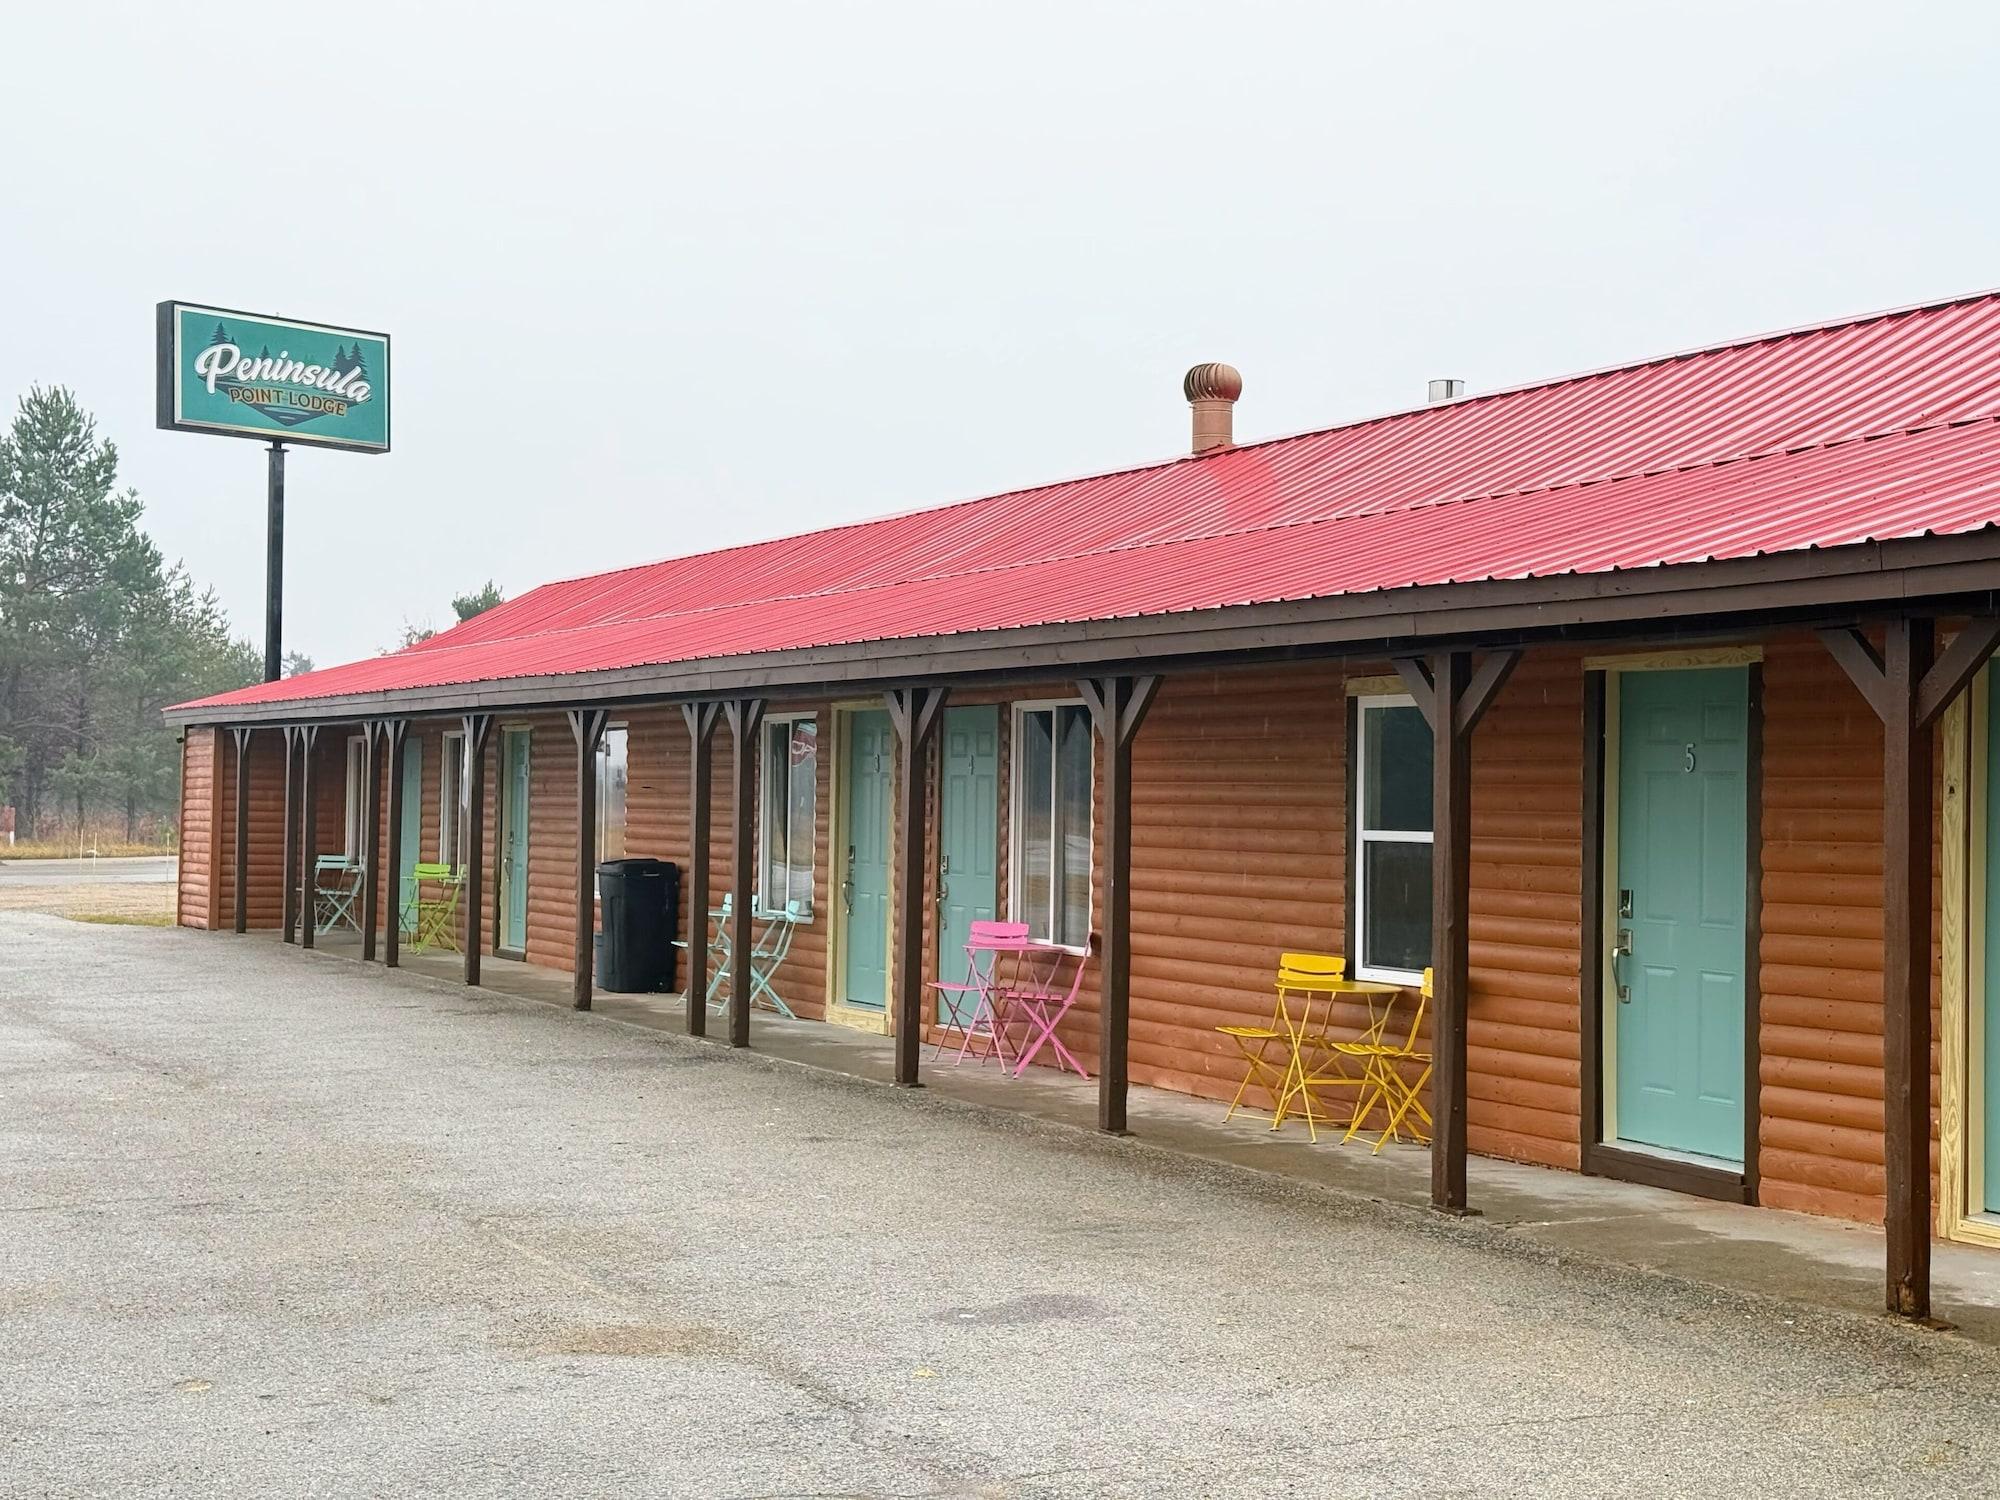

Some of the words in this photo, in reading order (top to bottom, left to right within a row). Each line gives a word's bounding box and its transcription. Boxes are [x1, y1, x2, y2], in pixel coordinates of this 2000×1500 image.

[194, 343, 371, 402] Peninsula
[230, 388, 283, 404] POINT
[289, 392, 346, 416] LODGE
[1684, 743, 1695, 773] 5
